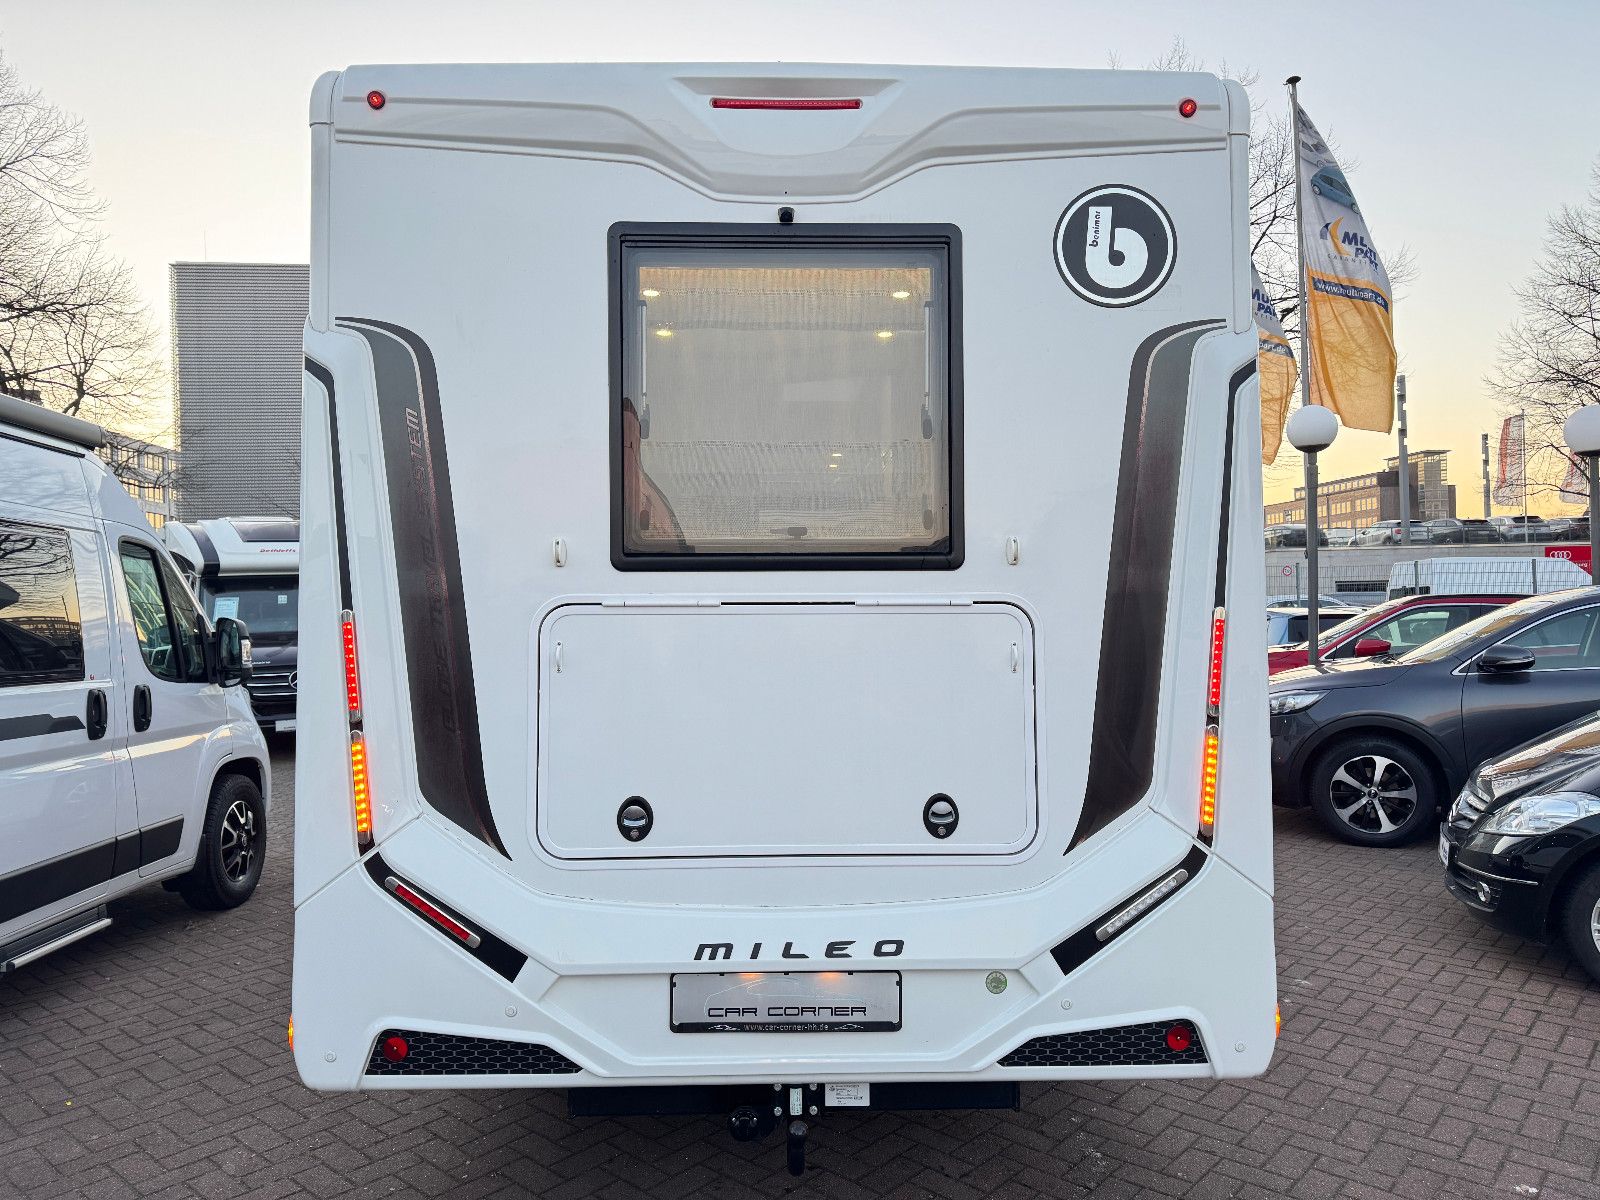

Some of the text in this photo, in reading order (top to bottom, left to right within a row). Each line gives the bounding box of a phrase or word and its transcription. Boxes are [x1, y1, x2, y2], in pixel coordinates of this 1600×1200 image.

[1089, 210, 1101, 248] benimar
[694, 939, 905, 960] MILEO
[708, 1006, 867, 1017] CAR CORNER
